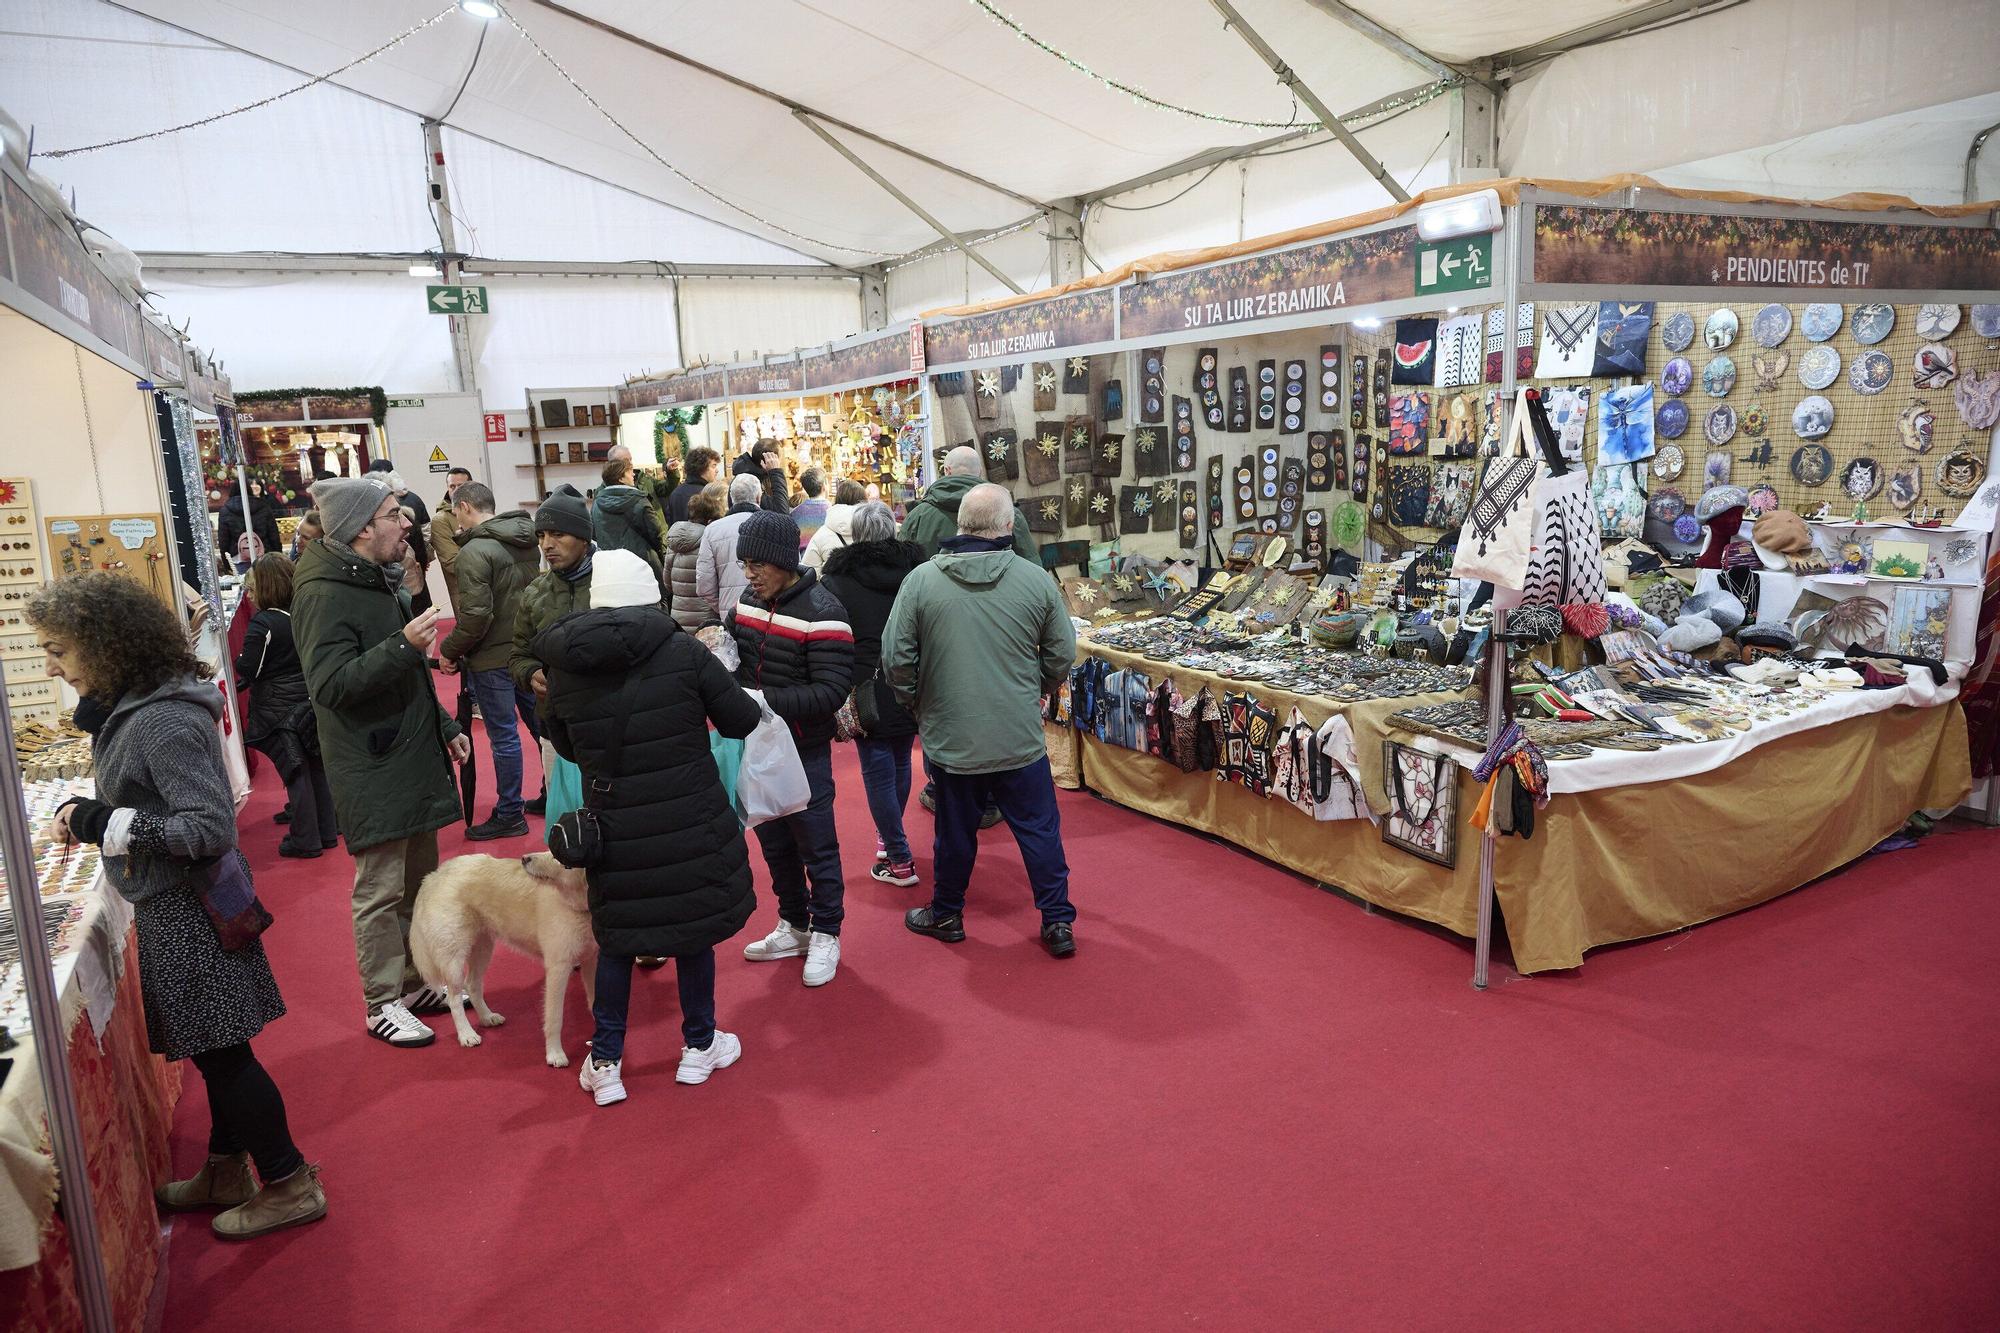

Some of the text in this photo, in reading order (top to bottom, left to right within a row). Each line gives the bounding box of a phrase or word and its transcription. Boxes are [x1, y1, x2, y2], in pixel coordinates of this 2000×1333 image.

[1727, 256, 1826, 285] PENDIENTES
[1830, 260, 1849, 285] de
[1184, 305, 1201, 328] SU
[1206, 303, 1222, 324] TA
[968, 344, 978, 359] SU
[980, 343, 990, 357] TA
[397, 399, 423, 408] SALIDA
